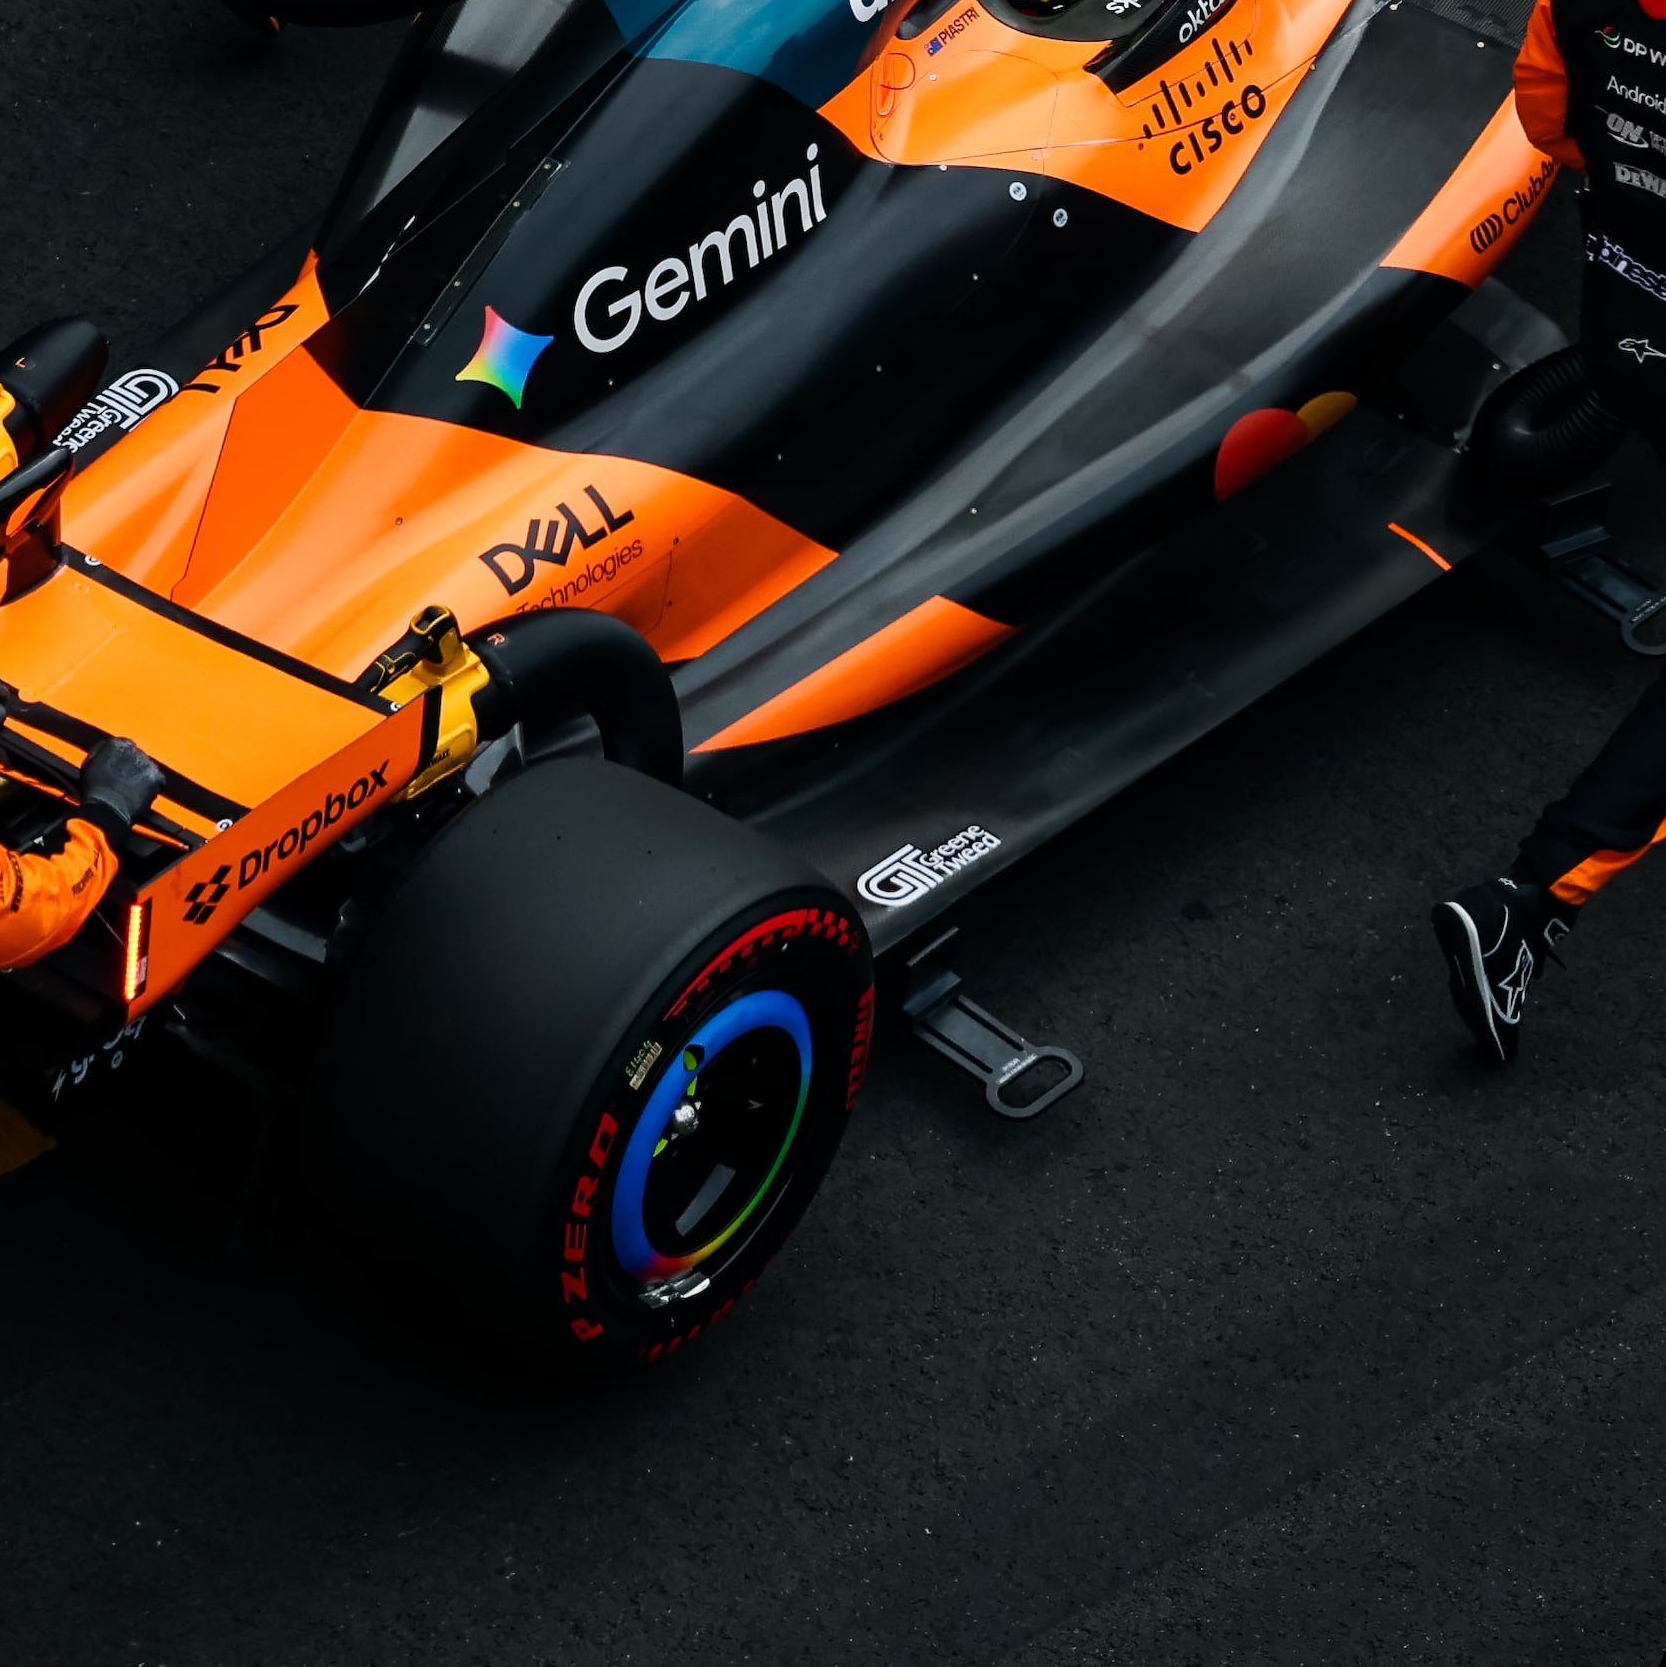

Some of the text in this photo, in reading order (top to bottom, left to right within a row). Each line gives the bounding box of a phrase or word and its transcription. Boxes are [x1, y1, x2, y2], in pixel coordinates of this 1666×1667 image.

[938, 6, 978, 48] PIASTRI
[1623, 38, 1648, 58] DP
[1501, 157, 1559, 225] ClubAv
[573, 142, 828, 353] Gemini
[479, 485, 635, 596] DELL
[516, 536, 643, 614] Technologies
[238, 759, 390, 889] Dropbox
[560, 1112, 619, 1304] ZERO
